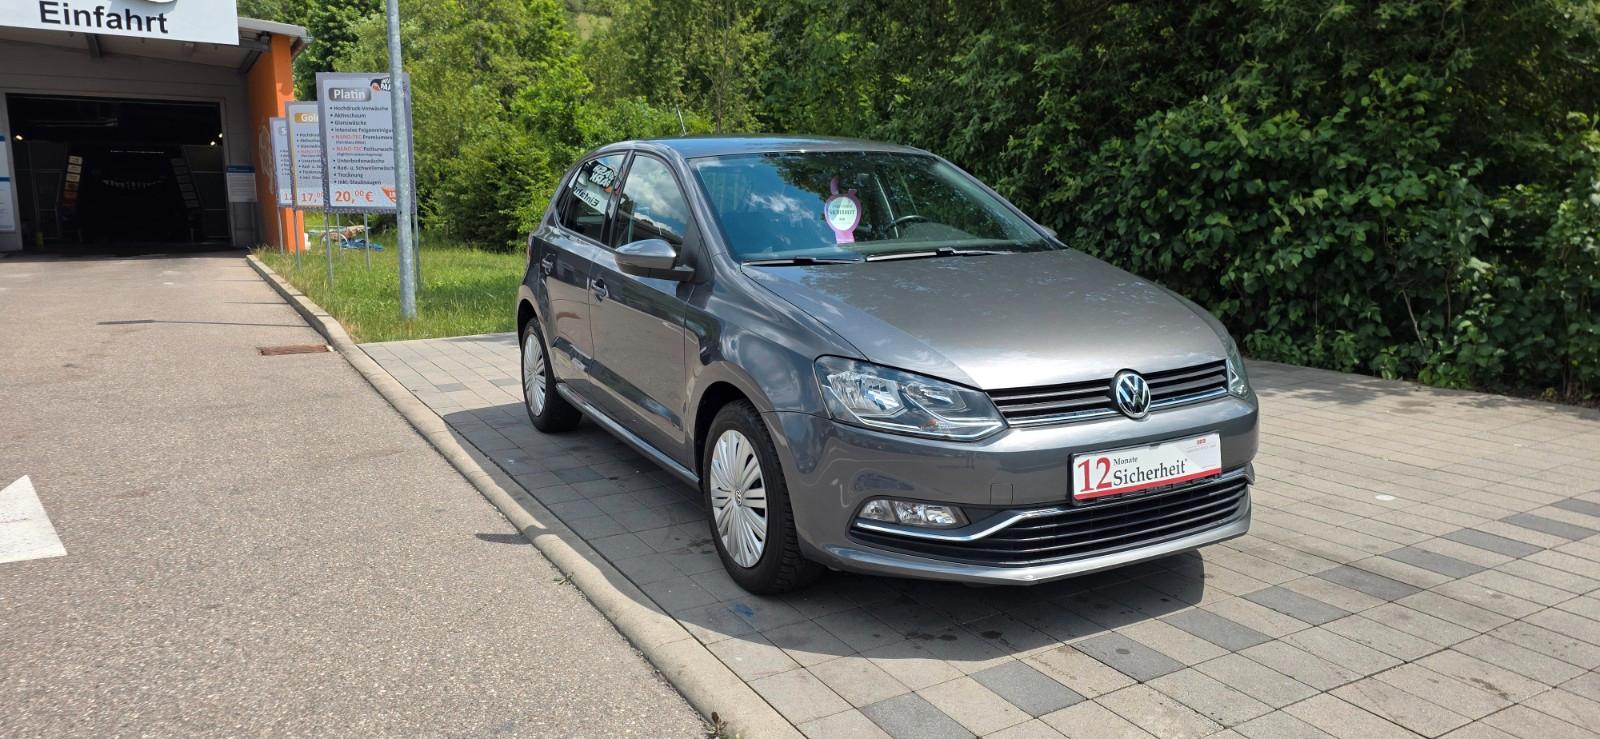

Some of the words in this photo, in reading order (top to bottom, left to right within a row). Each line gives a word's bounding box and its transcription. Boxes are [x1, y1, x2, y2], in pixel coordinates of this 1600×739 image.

[38, 0, 169, 34] Einfahrt
[333, 89, 366, 100] Platin
[1116, 373, 1151, 418] VW
[1077, 456, 1112, 493] 12
[1113, 455, 1139, 465] Monate
